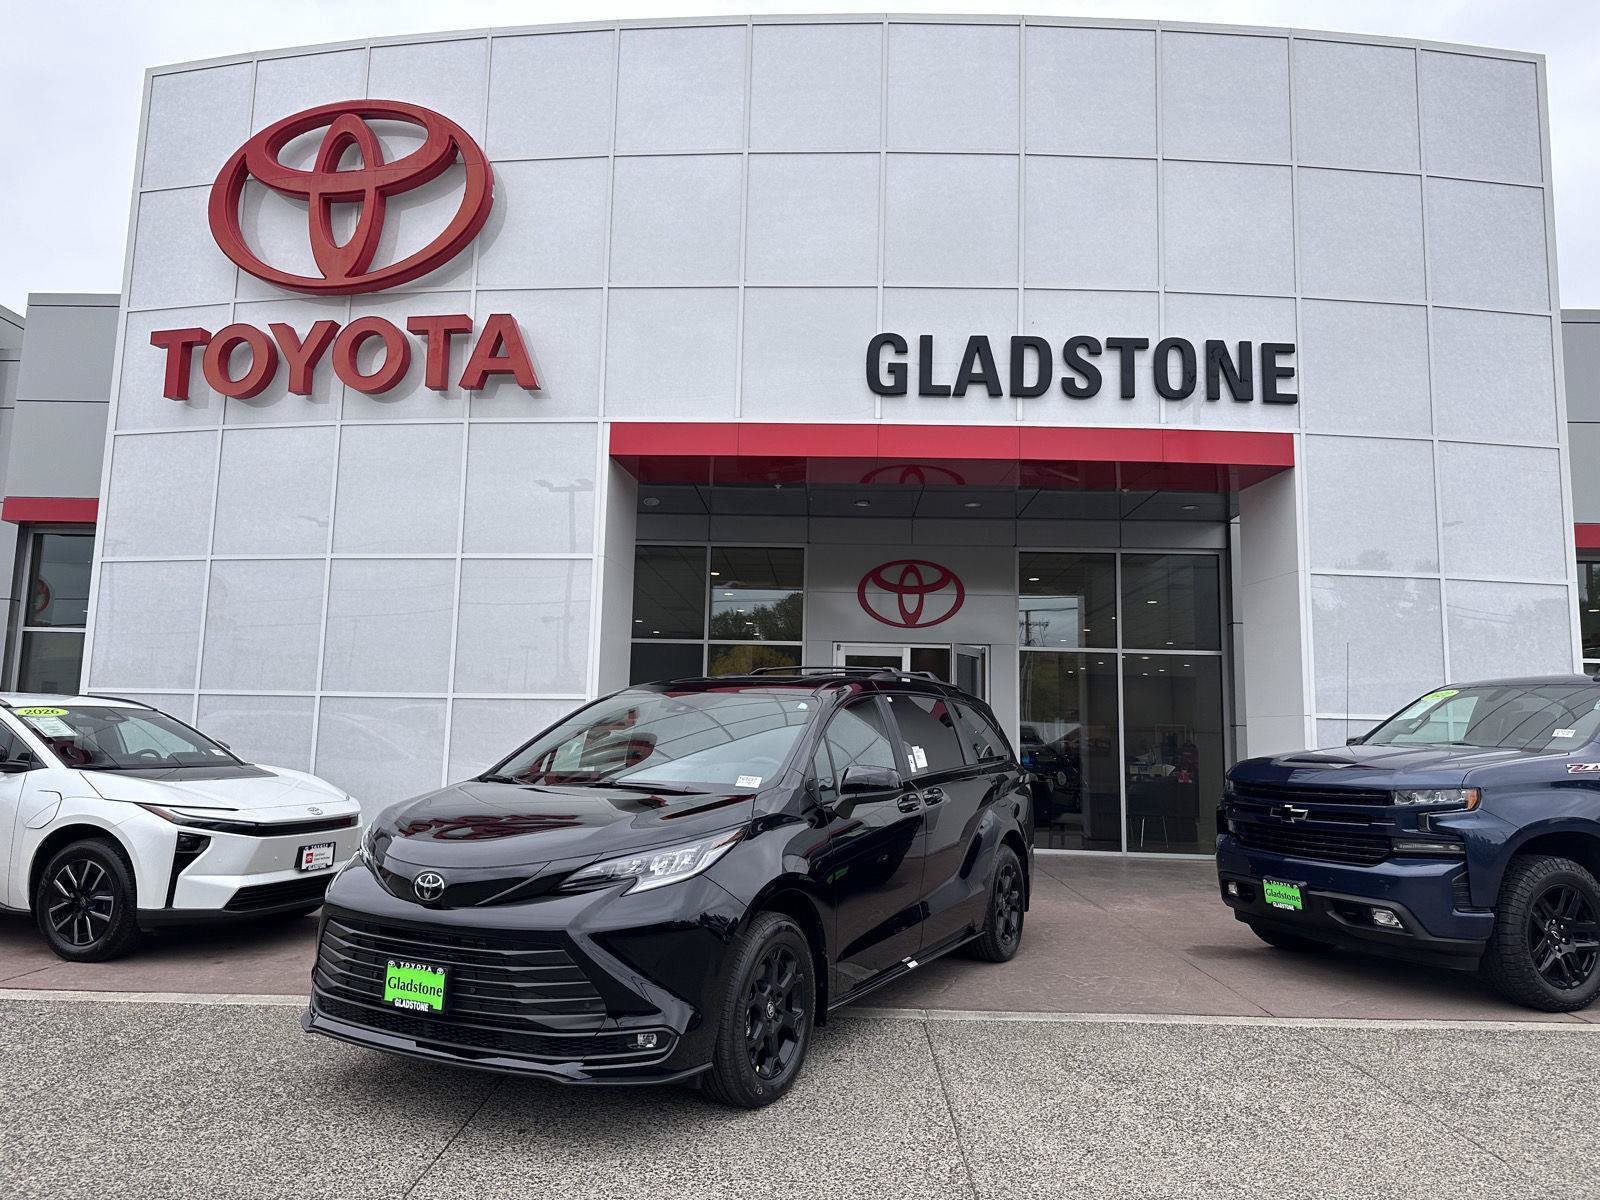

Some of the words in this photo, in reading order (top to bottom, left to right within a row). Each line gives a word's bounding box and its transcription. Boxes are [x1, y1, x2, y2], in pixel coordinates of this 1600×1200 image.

[150, 313, 541, 400] TOYOTA
[866, 332, 1298, 404] GLADSTONE
[1566, 763, 1600, 774] Z7
[1265, 888, 1301, 903] Gladstone
[400, 961, 432, 972] TOYOTA
[387, 976, 443, 998] Gladstone
[394, 998, 429, 1012] GLADSTONE
